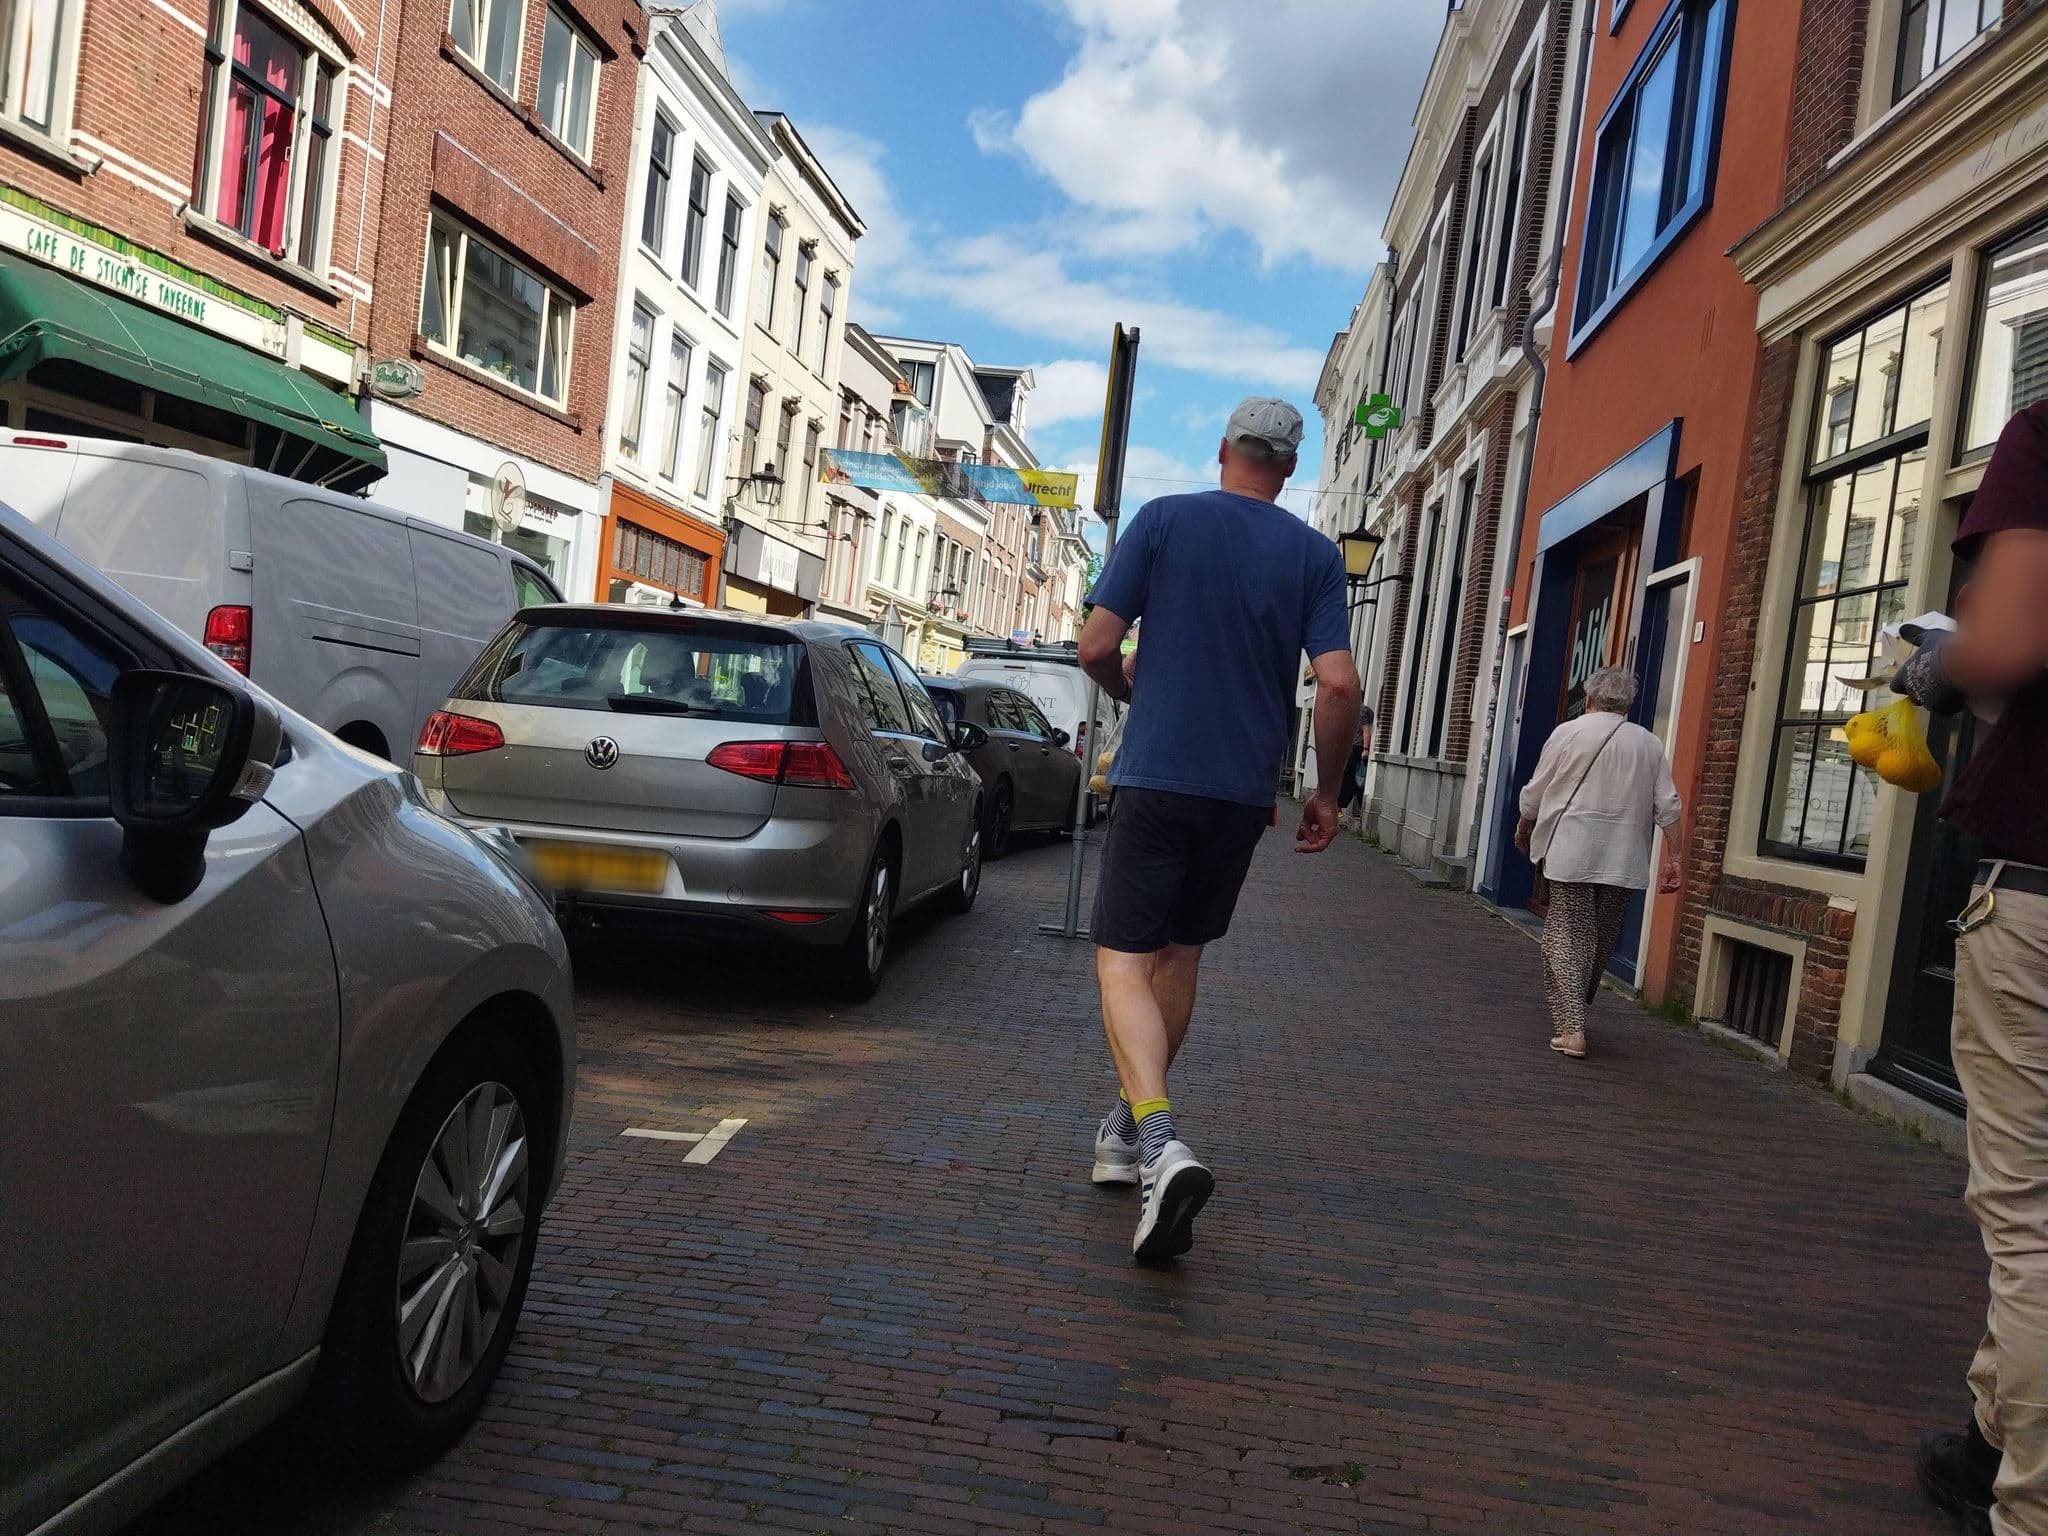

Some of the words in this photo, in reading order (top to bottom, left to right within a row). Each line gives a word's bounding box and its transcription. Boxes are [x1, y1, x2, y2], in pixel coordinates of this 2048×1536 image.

[27, 228, 58, 258] CAFÉ
[71, 246, 85, 270] DE
[159, 283, 206, 321] TAVEERNE
[1023, 482, 1072, 497] Utrecht
